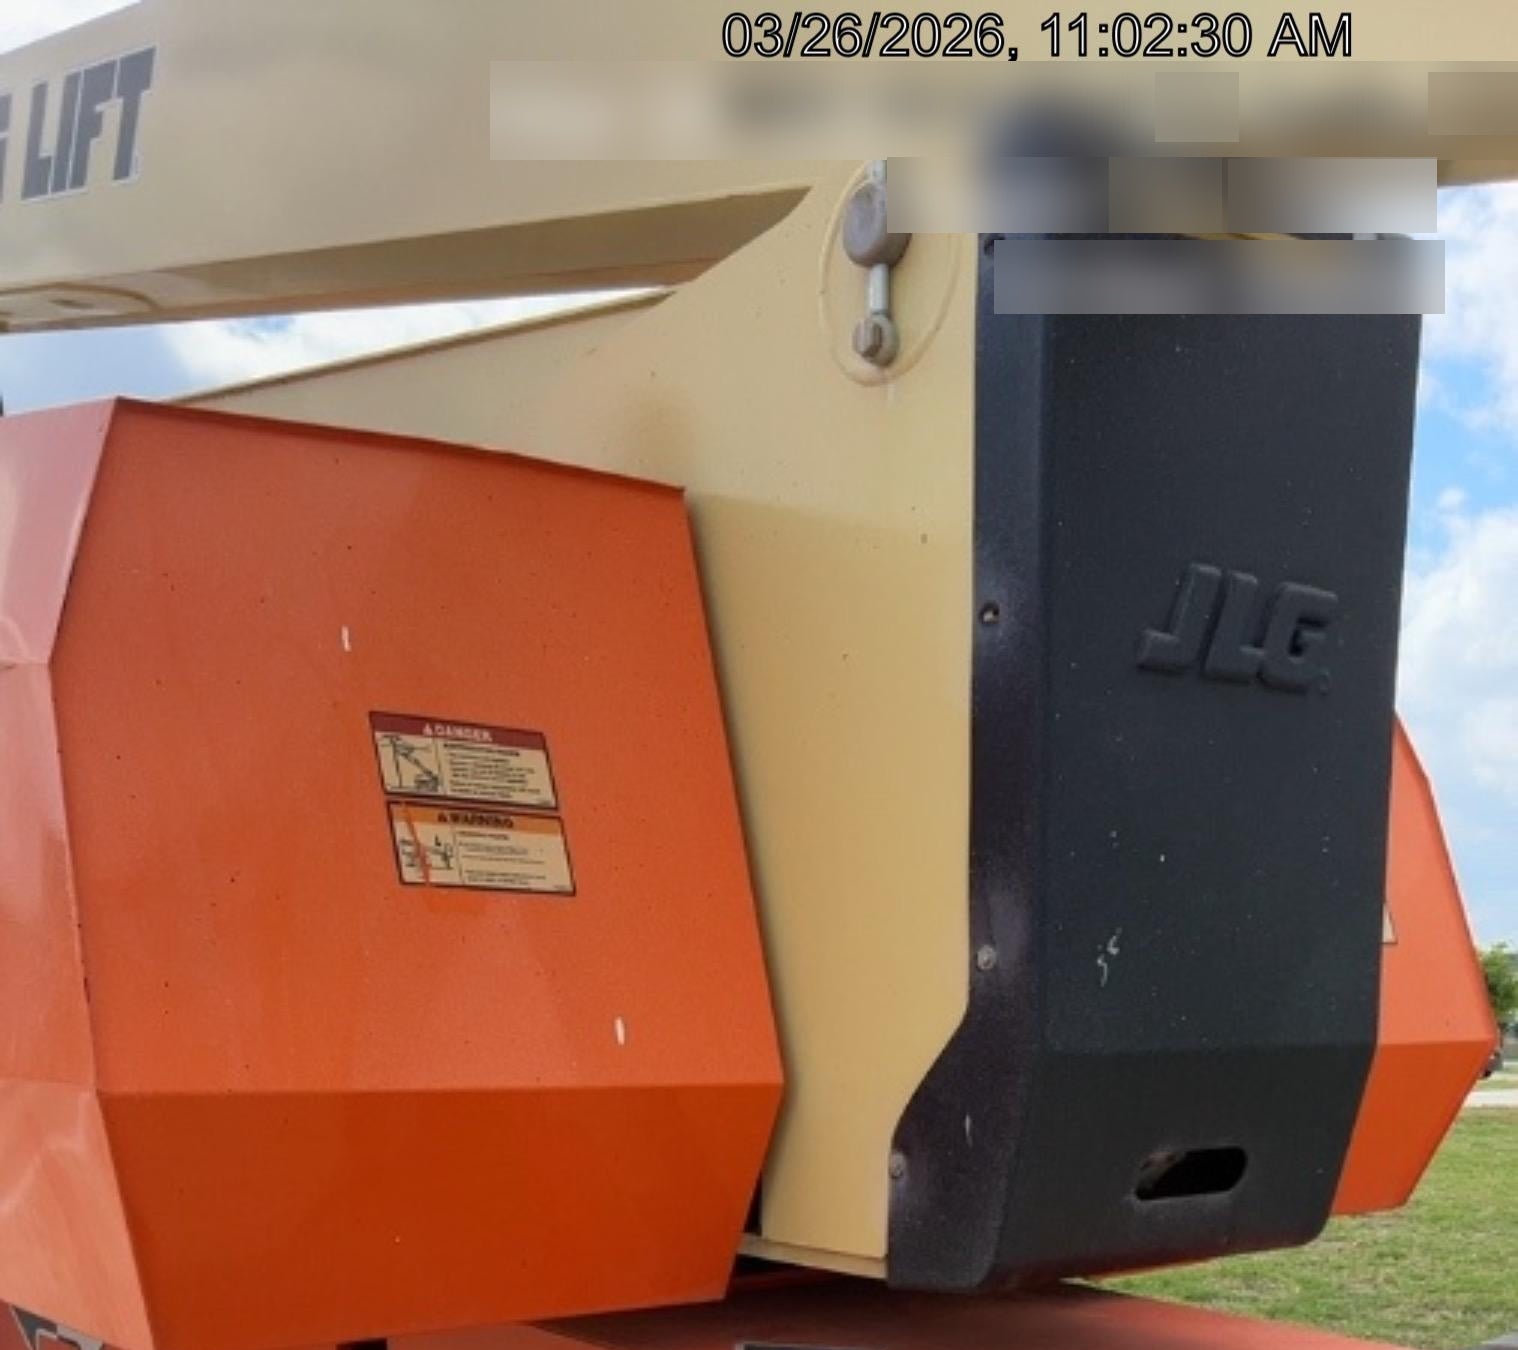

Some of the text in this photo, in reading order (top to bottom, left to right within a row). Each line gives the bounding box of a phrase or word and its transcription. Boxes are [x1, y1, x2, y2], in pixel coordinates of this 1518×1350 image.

[20, 46, 157, 201] LIFT
[1138, 563, 1338, 694] JLG
[434, 724, 493, 742] DANGER
[449, 813, 515, 829] WARNING
